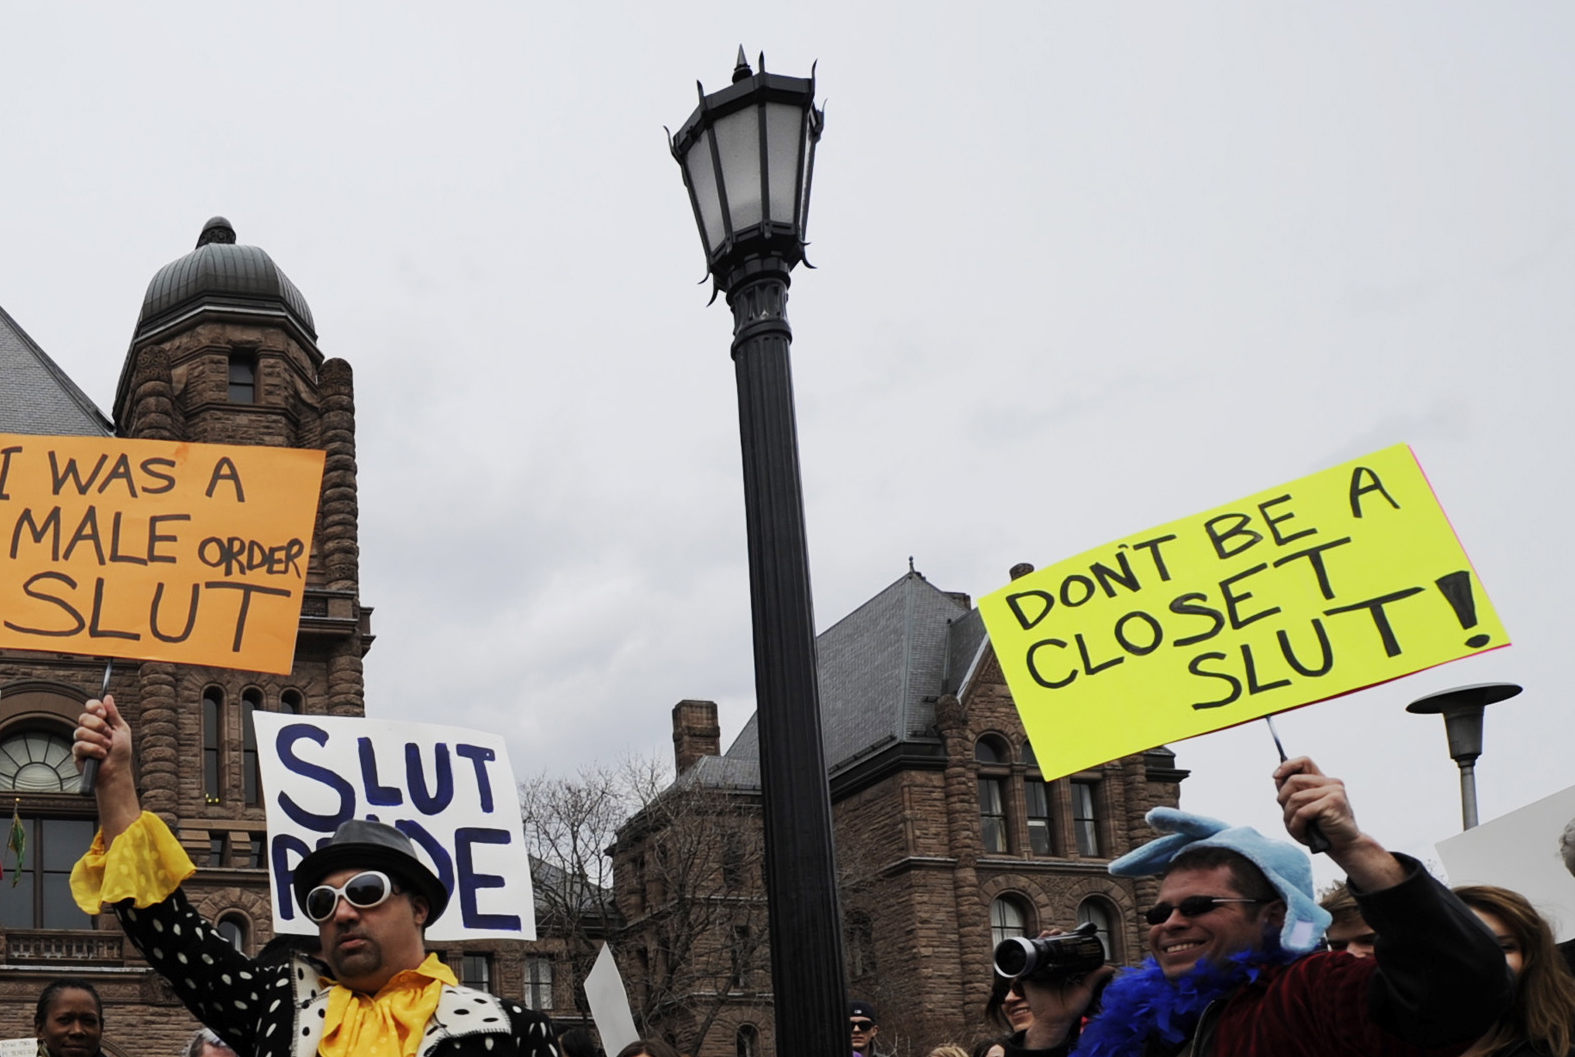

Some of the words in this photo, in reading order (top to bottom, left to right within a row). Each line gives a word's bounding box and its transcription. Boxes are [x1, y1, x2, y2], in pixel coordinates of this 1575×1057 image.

[48, 450, 176, 498] WAS
[205, 457, 246, 502] A
[9, 505, 192, 566] MALE
[198, 535, 305, 579] ORDER
[1005, 534, 1177, 631] DON'T
[1204, 494, 1319, 560] BE
[1348, 466, 1402, 518] A
[3, 571, 292, 653] SLUT
[1025, 536, 1352, 690] CLOSET
[1188, 569, 1492, 711] SLUT!
[275, 722, 496, 833] SLUT
[271, 814, 522, 932] PDE
